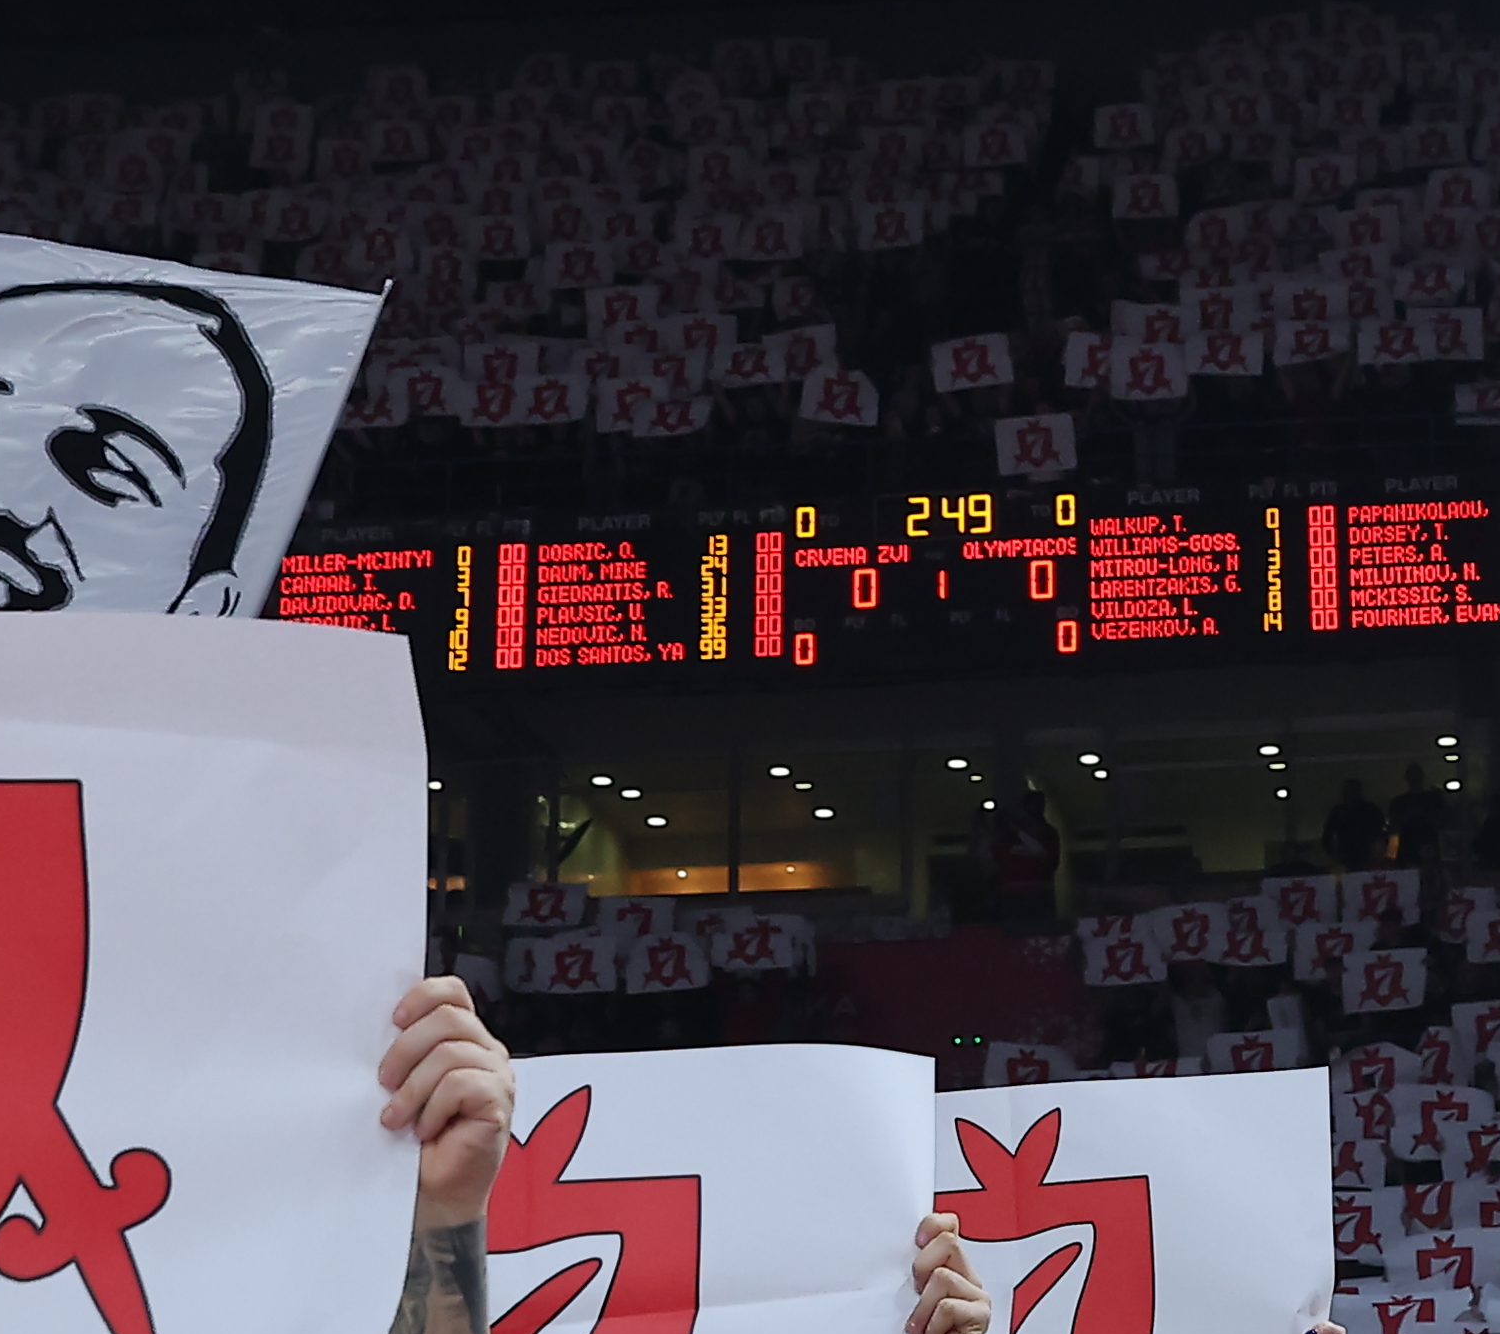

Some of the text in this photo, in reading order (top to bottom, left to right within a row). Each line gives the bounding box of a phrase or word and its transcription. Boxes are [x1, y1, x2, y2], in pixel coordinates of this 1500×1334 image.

[1056, 494, 1075, 525] 0
[1267, 508, 1279, 528] 0
[1309, 505, 1334, 526] 00
[796, 507, 815, 537] 0
[709, 535, 727, 555] 13
[755, 532, 783, 553] 00
[1274, 529, 1280, 547] 1
[1310, 526, 1335, 547] 00
[458, 546, 471, 566] 0
[500, 544, 527, 565] 00
[702, 556, 727, 576] 24
[755, 553, 783, 574] 00
[1268, 549, 1280, 569] 3
[1311, 547, 1336, 567] 00
[458, 566, 470, 587] 3
[499, 565, 526, 586] 00
[701, 577, 727, 597] 31
[755, 574, 783, 595] 00
[1030, 560, 1053, 599] 0
[1268, 570, 1281, 590] 5
[1311, 567, 1336, 588] 00
[458, 587, 471, 607] 7
[498, 586, 525, 607] 00
[853, 568, 878, 608] 0
[1269, 591, 1281, 611] 8
[1312, 588, 1337, 609] 00
[456, 609, 469, 629] 9
[498, 607, 525, 627] 00
[700, 597, 726, 618] 33
[754, 595, 782, 615] 00
[700, 618, 726, 638] 36
[754, 615, 782, 636] 00
[1264, 612, 1282, 631] 14
[1313, 609, 1338, 630] 00
[450, 627, 524, 650] 10 00
[700, 638, 726, 659] 99
[754, 636, 782, 657] 00
[1058, 621, 1077, 653] 0
[449, 648, 523, 670] 12 00
[794, 633, 815, 665] 0
